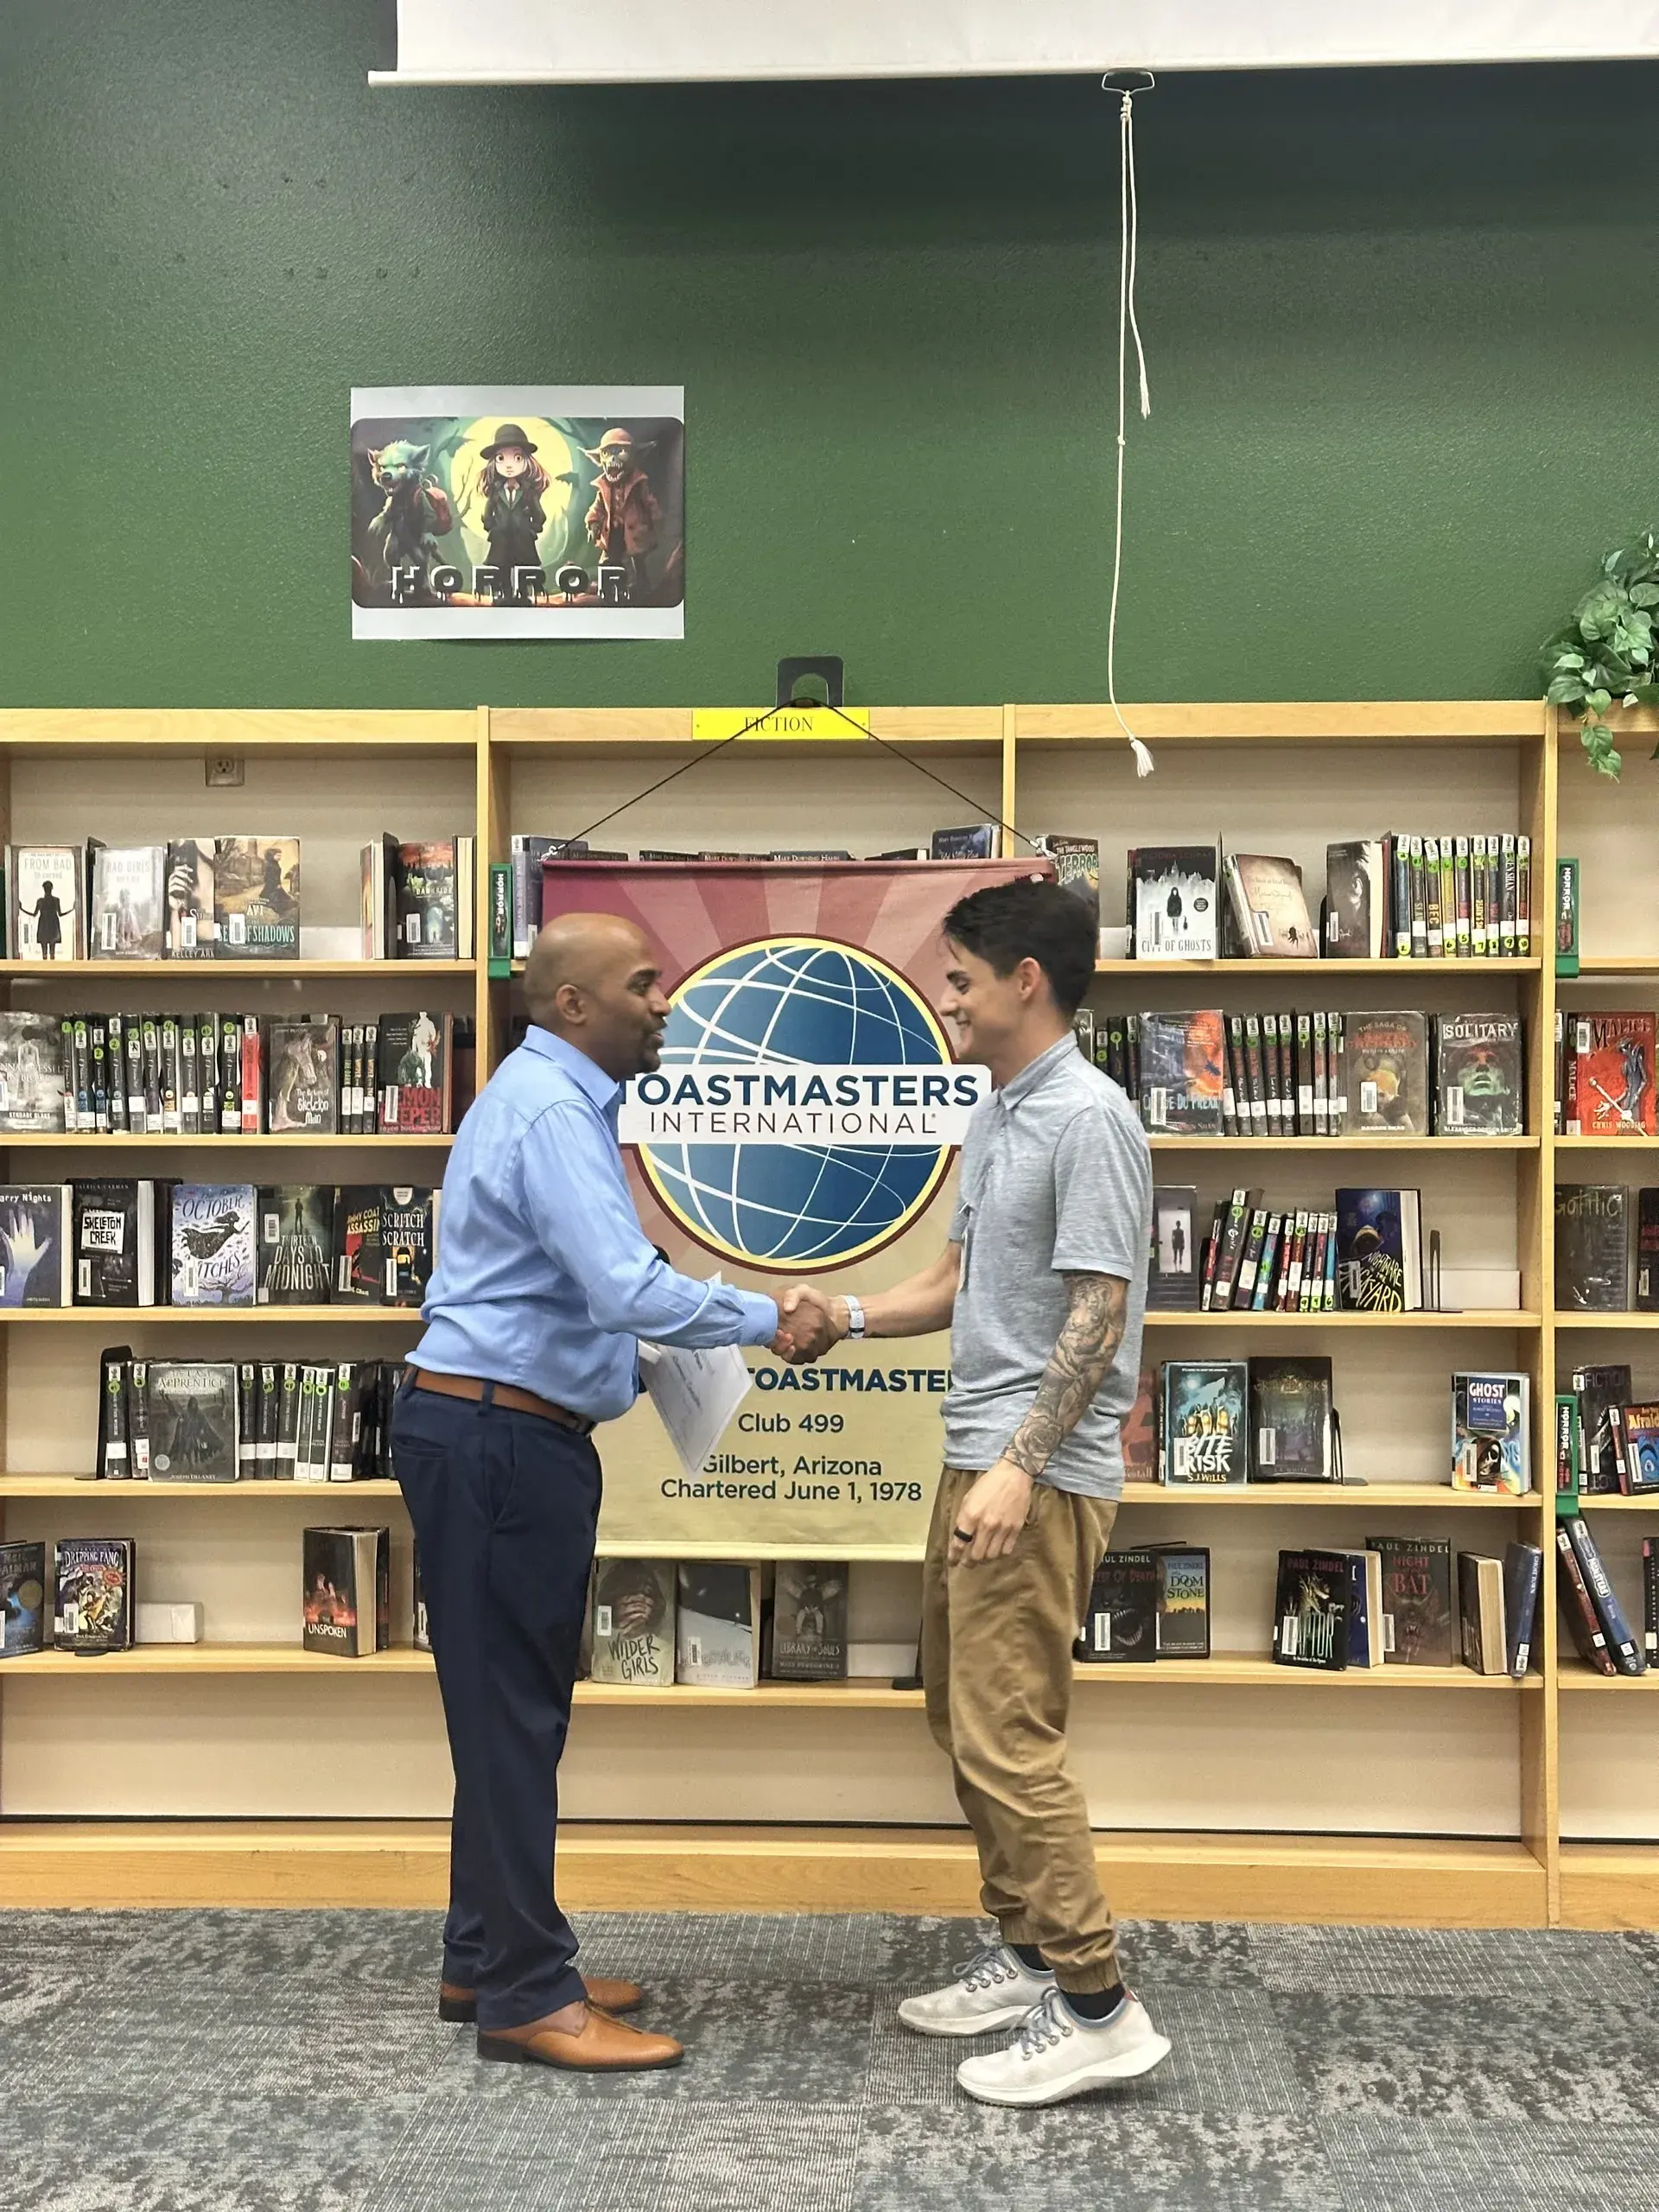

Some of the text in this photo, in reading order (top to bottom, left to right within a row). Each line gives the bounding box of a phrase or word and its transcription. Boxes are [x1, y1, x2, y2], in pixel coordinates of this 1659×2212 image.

[391, 564, 632, 604] HORROR
[744, 717, 796, 732] FICTION
[24, 858, 72, 871] FROM BAD
[1057, 854, 1099, 886] TERROR
[496, 873, 505, 918] HORROR
[1564, 867, 1573, 910] HORROR
[247, 905, 264, 917] AVI
[1428, 904, 1440, 925] BEC
[252, 925, 295, 942] SHADOWS
[1165, 938, 1211, 952] OF GHOSTS
[1358, 1024, 1372, 1033] THE
[1443, 1022, 1518, 1039] SOLITARY
[1591, 1018, 1650, 1052] MALICE
[1568, 1060, 1577, 1101] MALICE
[620, 1074, 979, 1106] TOASTMASTERS
[1177, 1093, 1189, 1109] DU
[0, 1192, 52, 1203] arry Nights
[182, 1195, 245, 1220] OCTOBER
[84, 1216, 121, 1230] SKELETON
[382, 1213, 424, 1229] SCRITCH
[90, 1230, 117, 1245] CREEK
[281, 1234, 318, 1246] THIRTEEN
[382, 1231, 424, 1247] SCRATCH
[275, 1244, 324, 1265] DAYS TO
[198, 1250, 240, 1279] ITCHES
[1368, 1250, 1403, 1287] NIGHTMARE
[263, 1262, 333, 1291] MIDNIGHT
[187, 1369, 214, 1377] LAST
[747, 1368, 952, 1393] OASTMASTE
[158, 1377, 226, 1389] APPRENTICE
[1469, 1382, 1505, 1398] GHOST
[737, 1414, 844, 1434] Club 499
[1560, 1406, 1570, 1450] HORROR
[1188, 1434, 1233, 1457] BITE
[703, 1454, 882, 1478] Gilbert, Arizona
[1188, 1454, 1231, 1472] RISK
[661, 1478, 922, 1503] Chartered June 1, 1978
[1407, 1544, 1449, 1554] ZINDEL
[65, 1550, 99, 1567] DRIPPING
[1287, 1558, 1344, 1573] PAUL ZINDEL
[1393, 1556, 1430, 1567] NIGHT
[1171, 1575, 1204, 1588] DOOM
[1393, 1573, 1431, 1596] BAT
[1167, 1588, 1205, 1599] STONE
[308, 1623, 347, 1638] UNSPOKEN
[1296, 1611, 1334, 1659] APTOR
[607, 1632, 660, 1661] WILDER
[780, 1643, 840, 1656] LIBRARY SOULS
[621, 1656, 659, 1681] GIRLS
